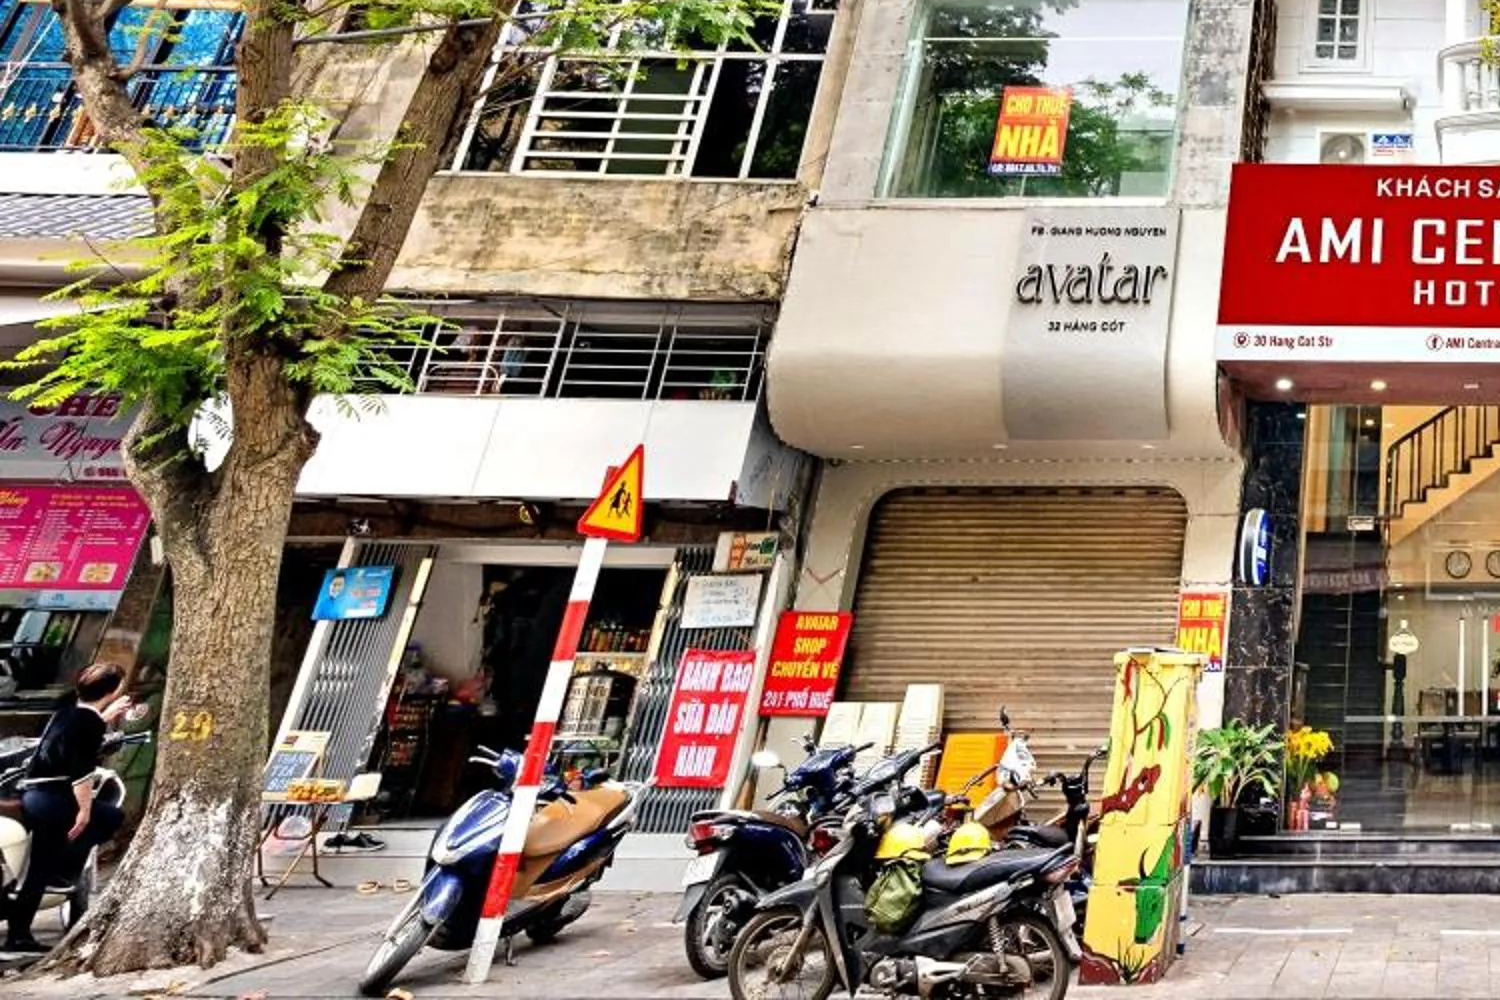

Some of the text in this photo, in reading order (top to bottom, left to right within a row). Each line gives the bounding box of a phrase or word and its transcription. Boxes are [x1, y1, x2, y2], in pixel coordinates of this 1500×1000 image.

[996, 118, 1058, 157] NHÀ
[1376, 173, 1471, 198] KHÁCH
[1275, 216, 1384, 264] AMI
[1016, 251, 1168, 306] avatar
[1254, 334, 1267, 347] 30
[1446, 337, 1465, 349] AMI
[796, 615, 839, 631] AVATAR
[793, 637, 826, 655] SHOP
[720, 661, 753, 692] BAO
